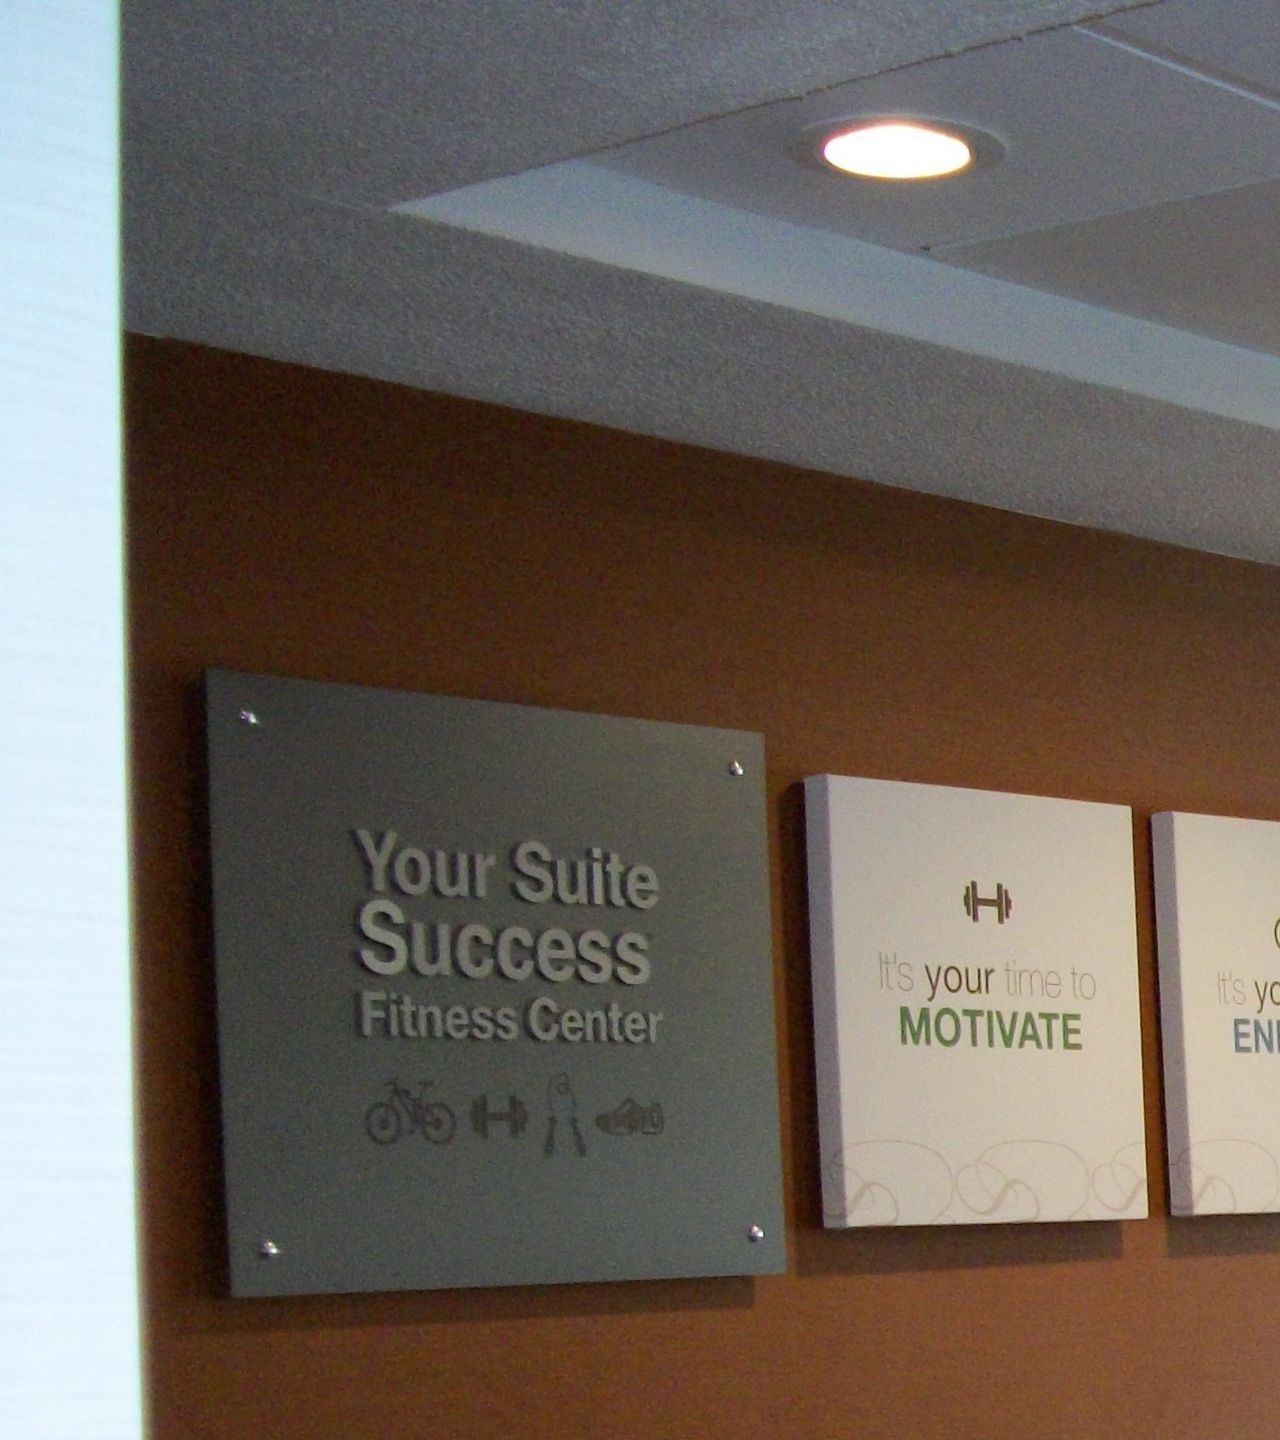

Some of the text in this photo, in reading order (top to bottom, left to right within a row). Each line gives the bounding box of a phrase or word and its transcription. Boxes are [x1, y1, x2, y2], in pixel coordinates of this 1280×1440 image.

[353, 828, 660, 909] Your Suite
[358, 899, 651, 985] Success
[878, 951, 1097, 1002] It's your time to
[1217, 970, 1247, 1006] It's
[360, 992, 664, 1043] Fitness Center
[899, 1005, 1083, 1051] MOTIVATE
